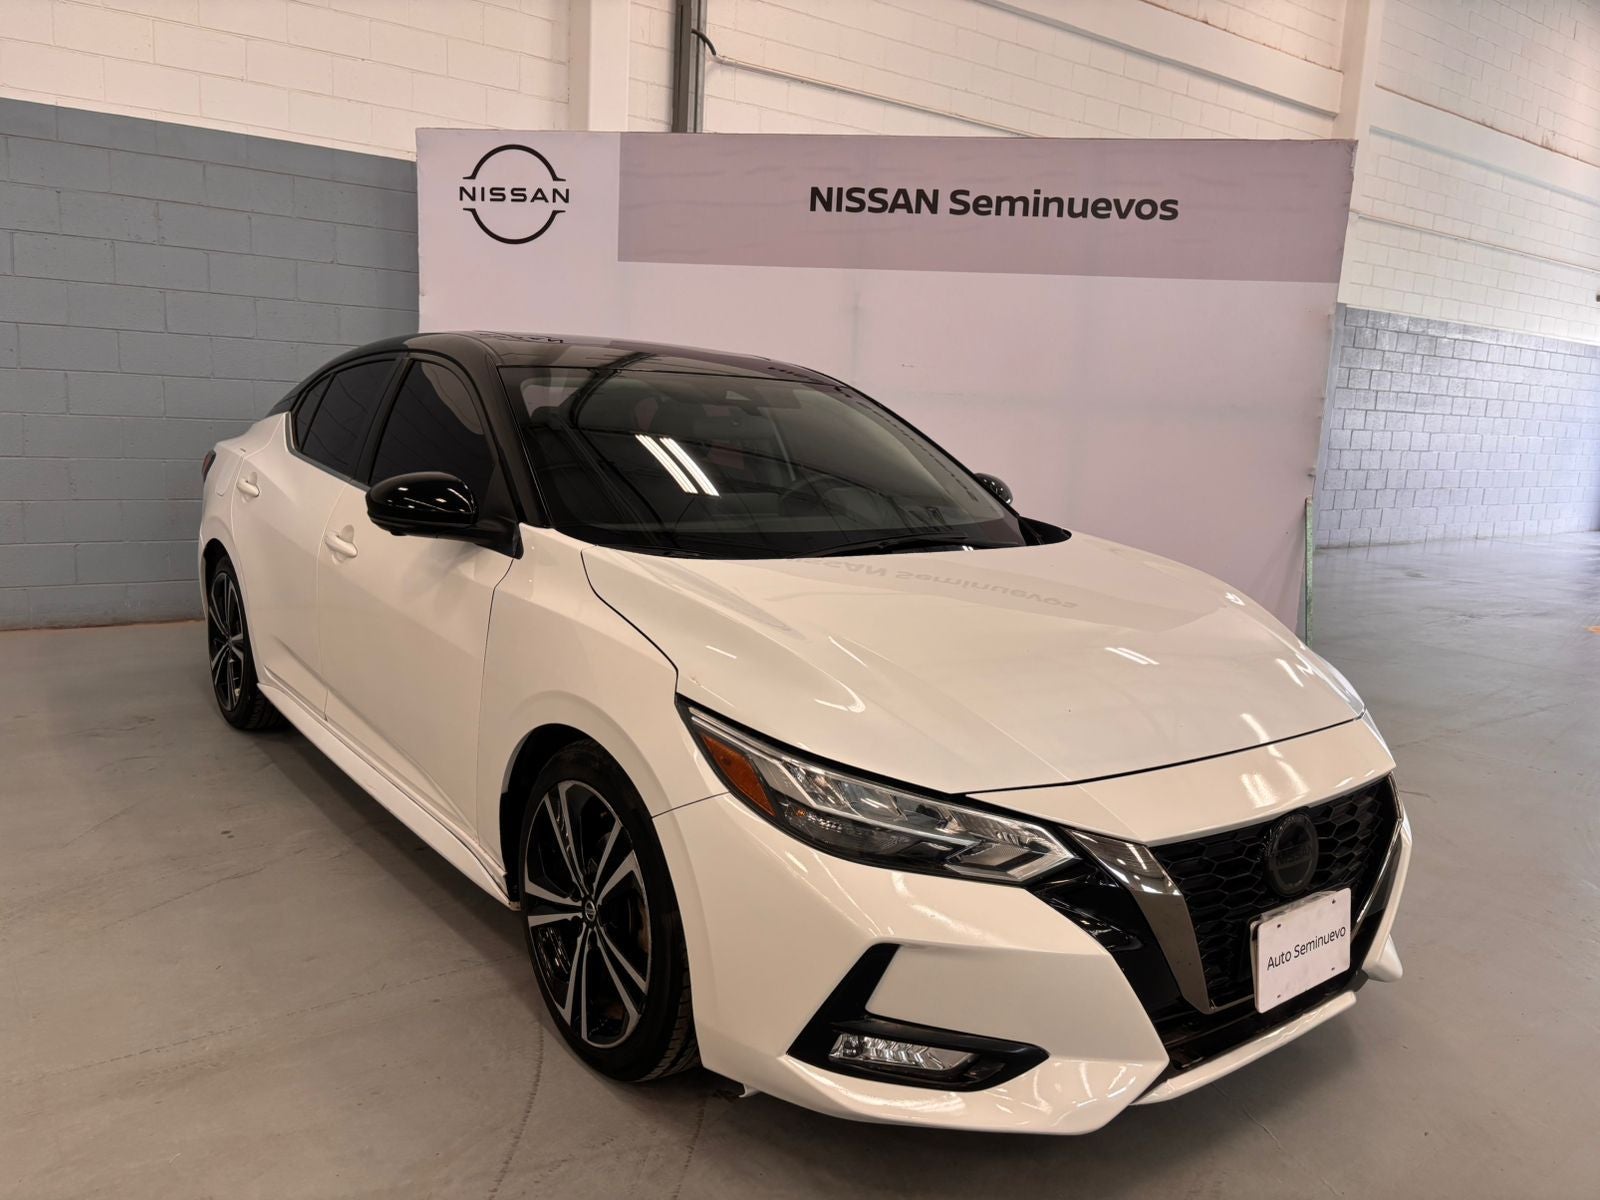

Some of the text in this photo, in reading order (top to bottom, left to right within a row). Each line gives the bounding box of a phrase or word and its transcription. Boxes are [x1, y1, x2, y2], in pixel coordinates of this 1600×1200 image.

[459, 186, 570, 203] NISSAN
[809, 186, 1179, 221] NISSAN Seminuevos
[1267, 926, 1347, 971] Auto Seminuevo
